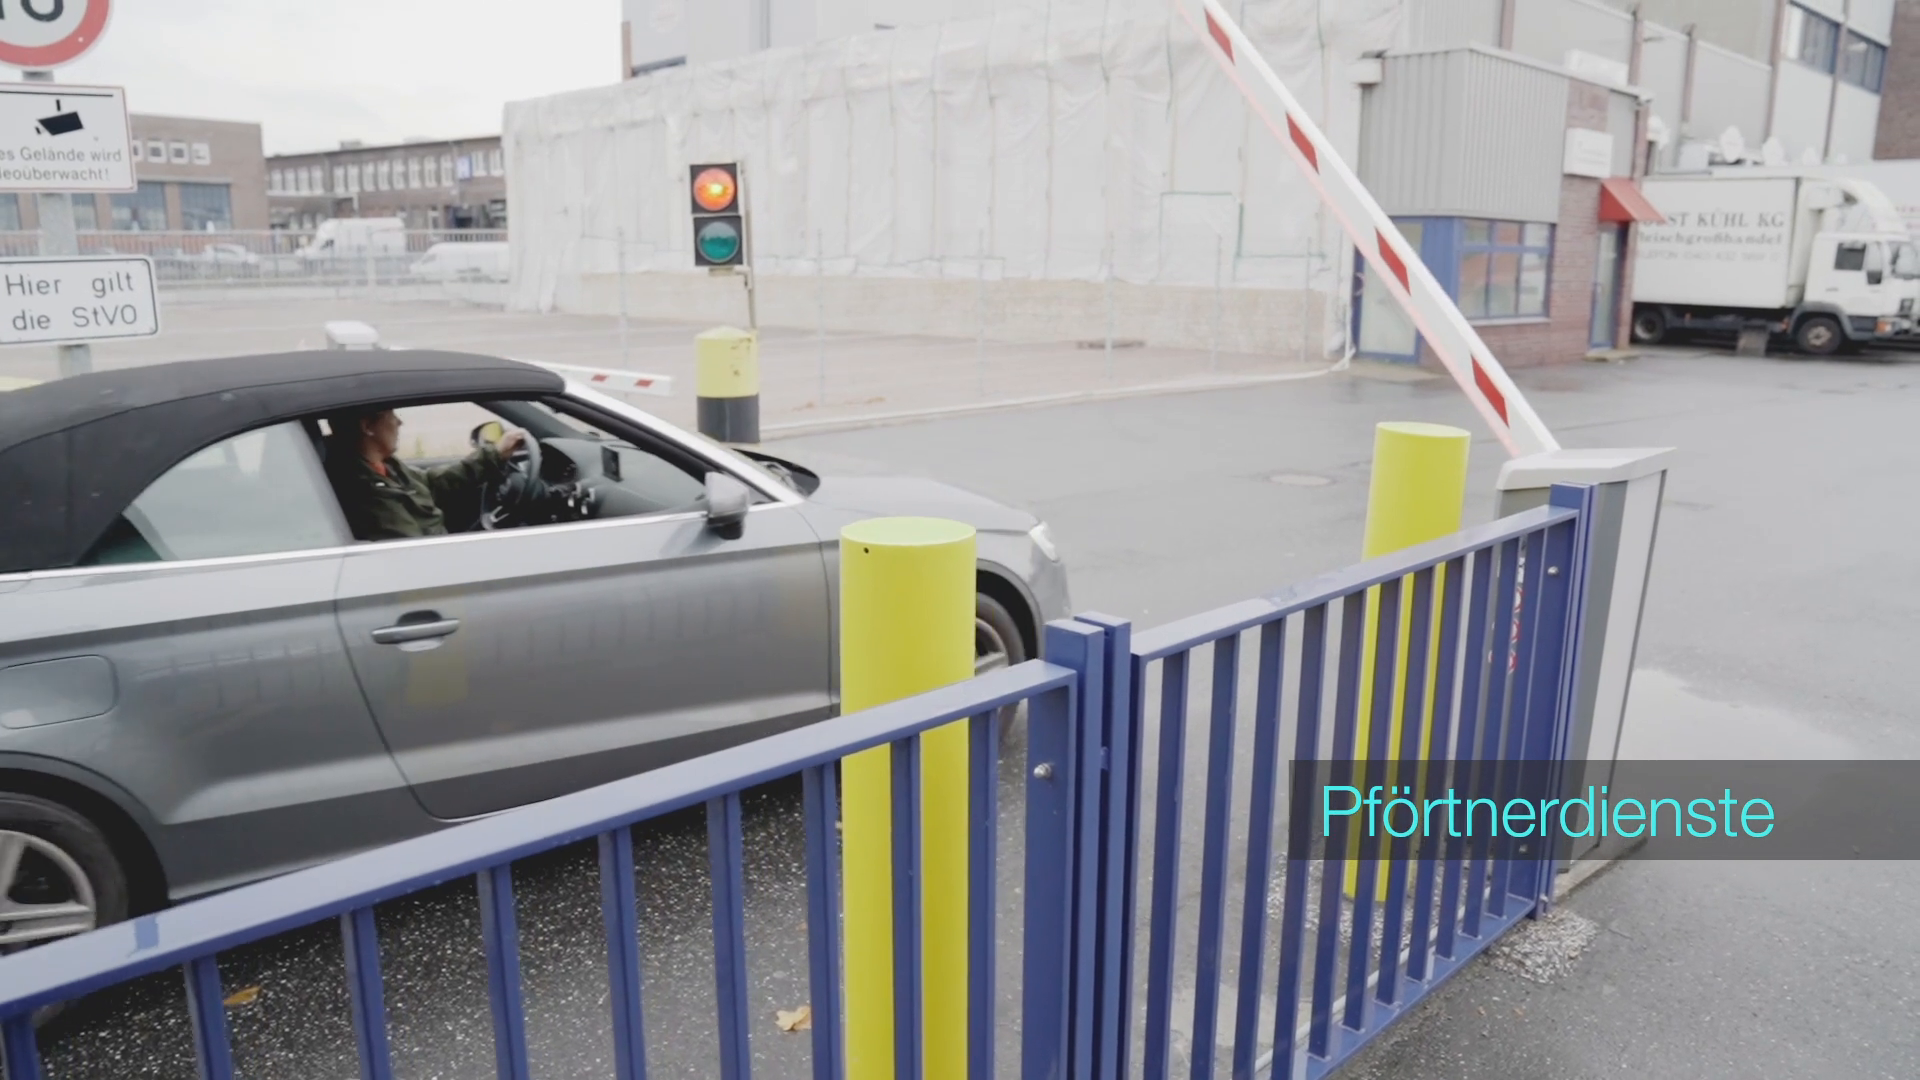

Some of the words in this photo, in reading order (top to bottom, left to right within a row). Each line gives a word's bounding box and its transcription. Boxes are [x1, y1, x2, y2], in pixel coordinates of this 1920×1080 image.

[20, 146, 85, 162] Gelände
[90, 148, 122, 162] wird
[0, 165, 110, 181] eoüberwacht!
[1696, 207, 1749, 228] KÜHL
[1757, 211, 1785, 228] KG
[5, 273, 62, 296] Hier
[91, 271, 134, 299] gilt
[12, 308, 51, 331] die
[72, 304, 137, 328] StVO
